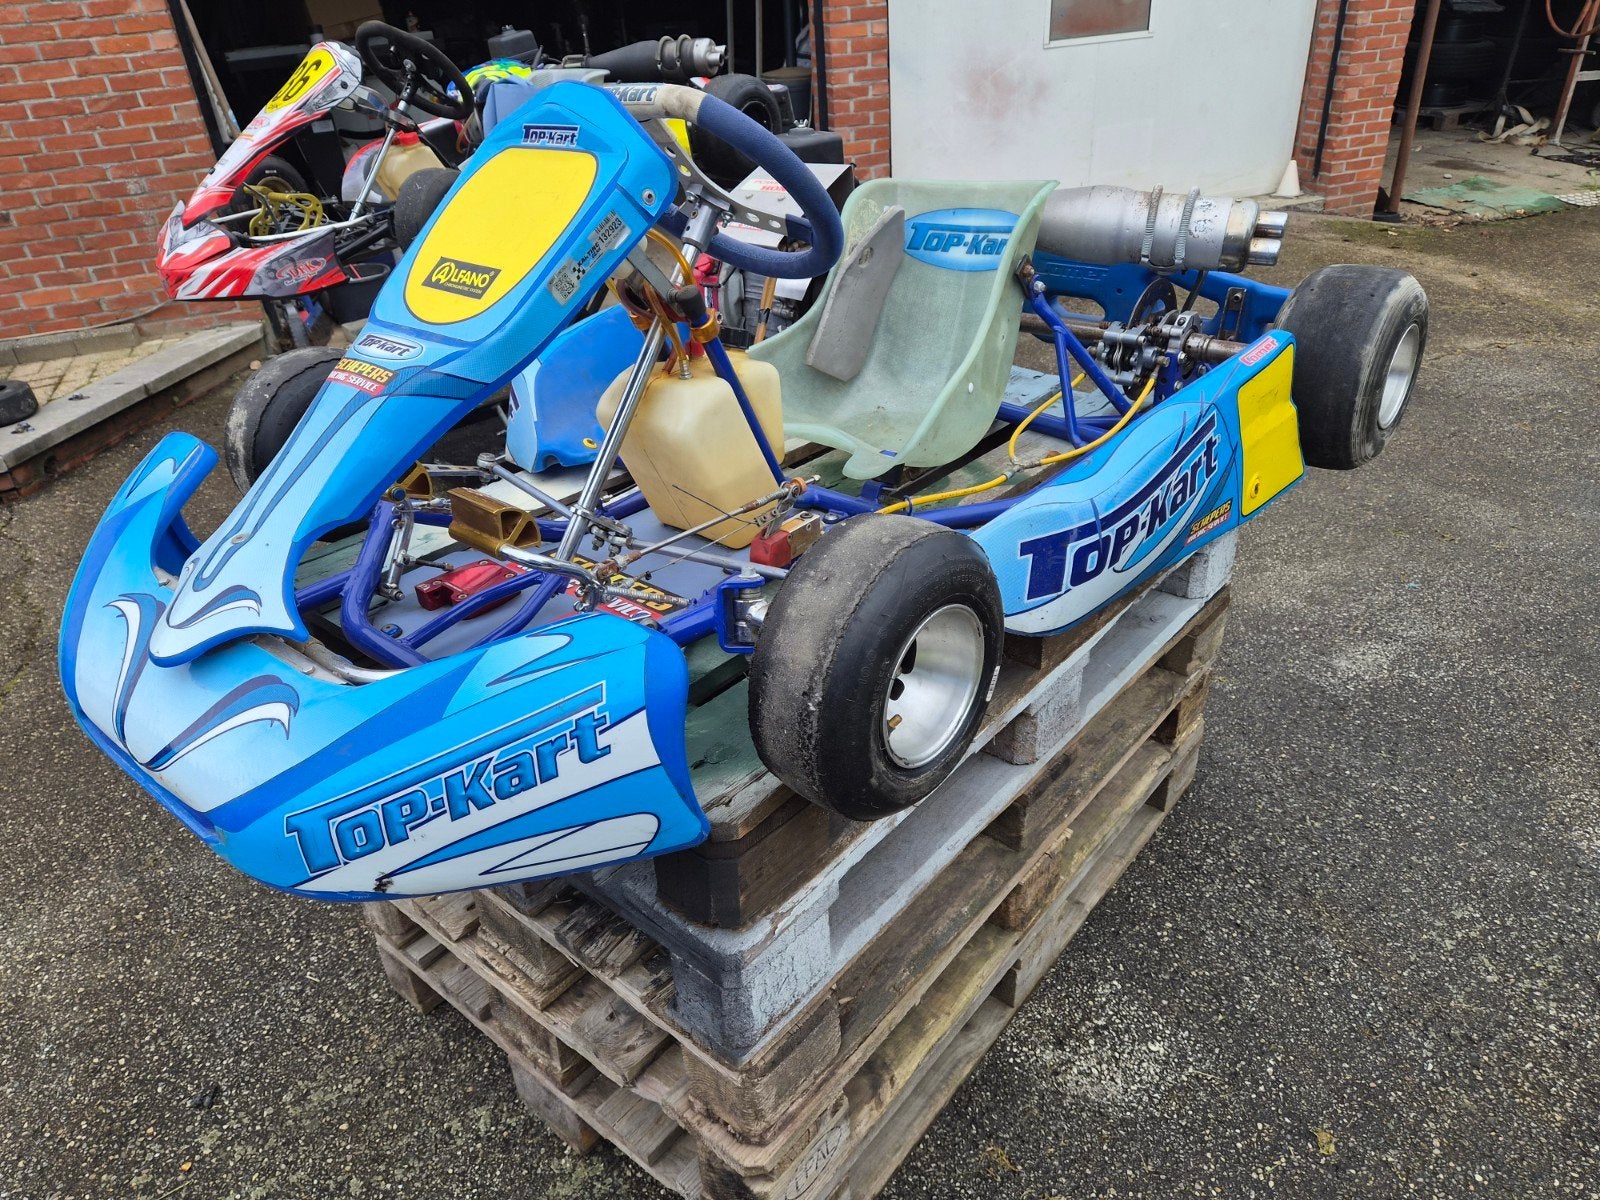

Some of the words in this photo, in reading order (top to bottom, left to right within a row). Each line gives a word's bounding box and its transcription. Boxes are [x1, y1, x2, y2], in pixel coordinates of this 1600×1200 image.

[599, 217, 622, 243] 132923
[431, 261, 490, 288] ALFANO
[347, 374, 379, 392] SERVICE
